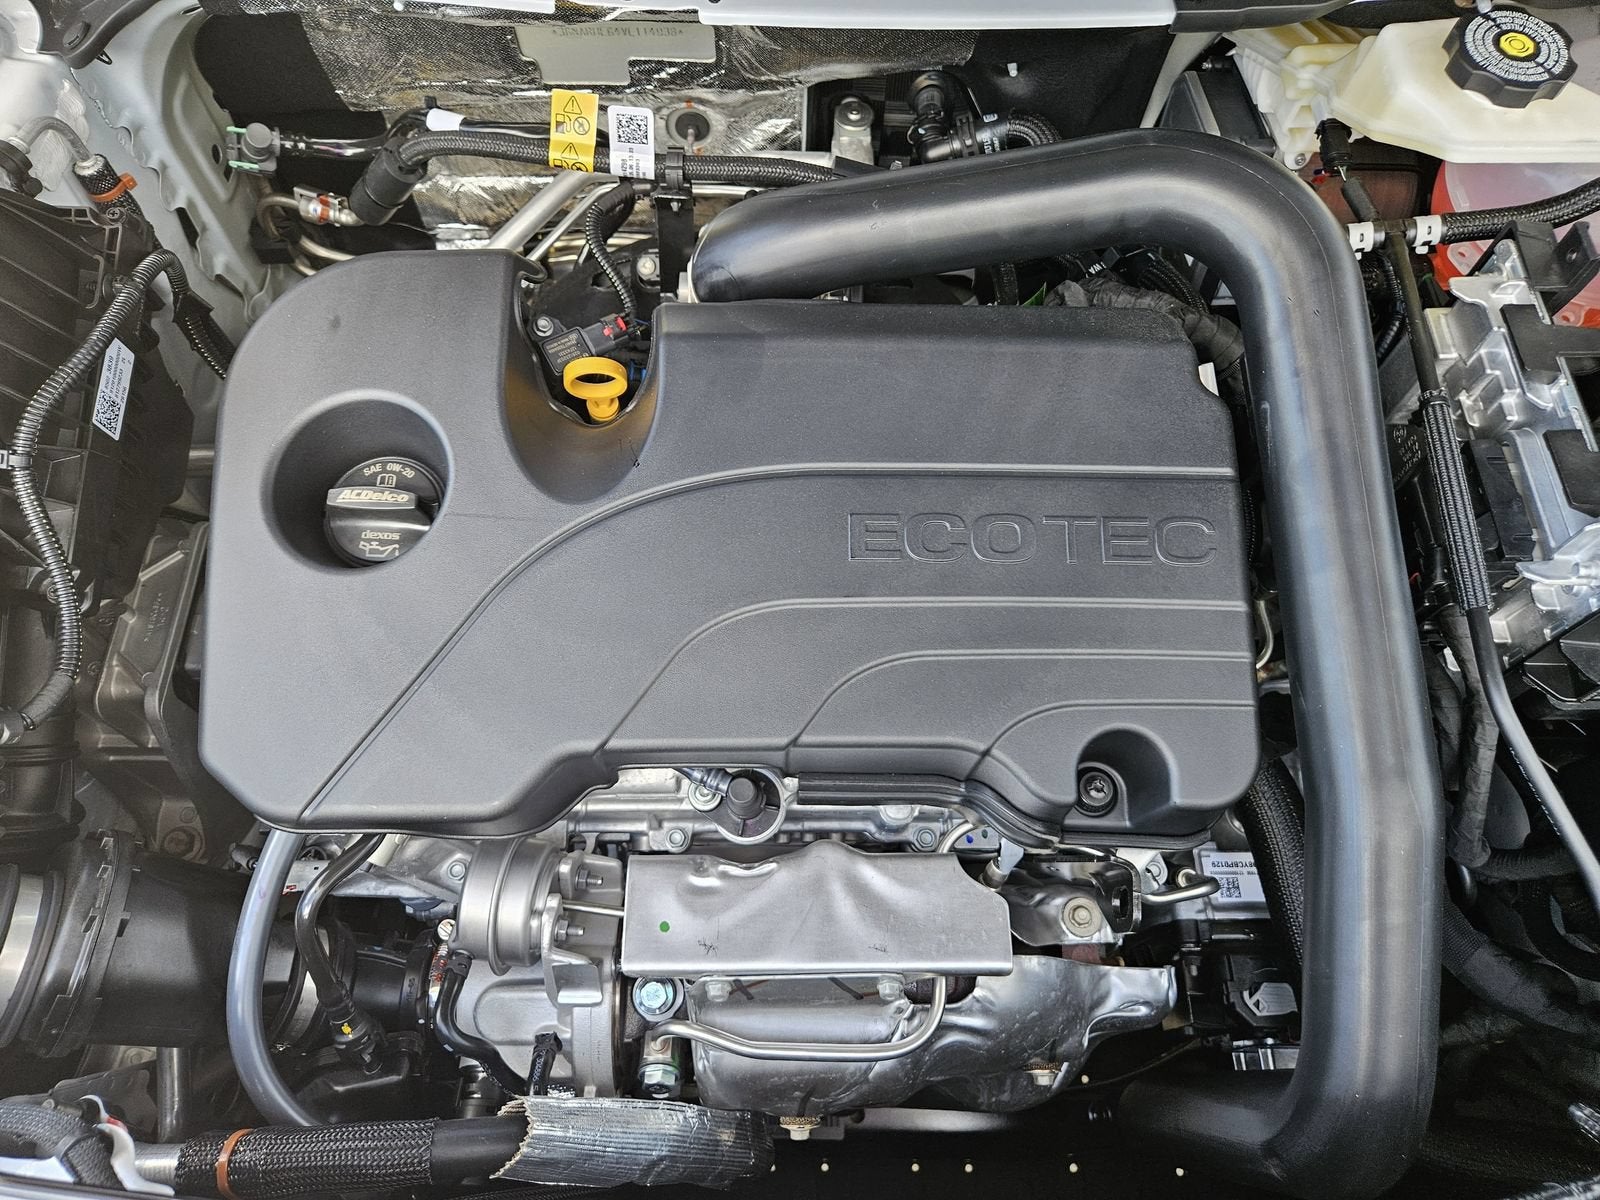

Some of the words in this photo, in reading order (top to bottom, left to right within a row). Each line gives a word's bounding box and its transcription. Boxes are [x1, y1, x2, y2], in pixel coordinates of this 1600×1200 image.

[363, 463, 382, 476] SAE
[386, 462, 415, 478] 0W-20
[337, 489, 410, 503] ACDelco
[361, 530, 401, 540] dexos
[848, 512, 1217, 567] ECOTEC
